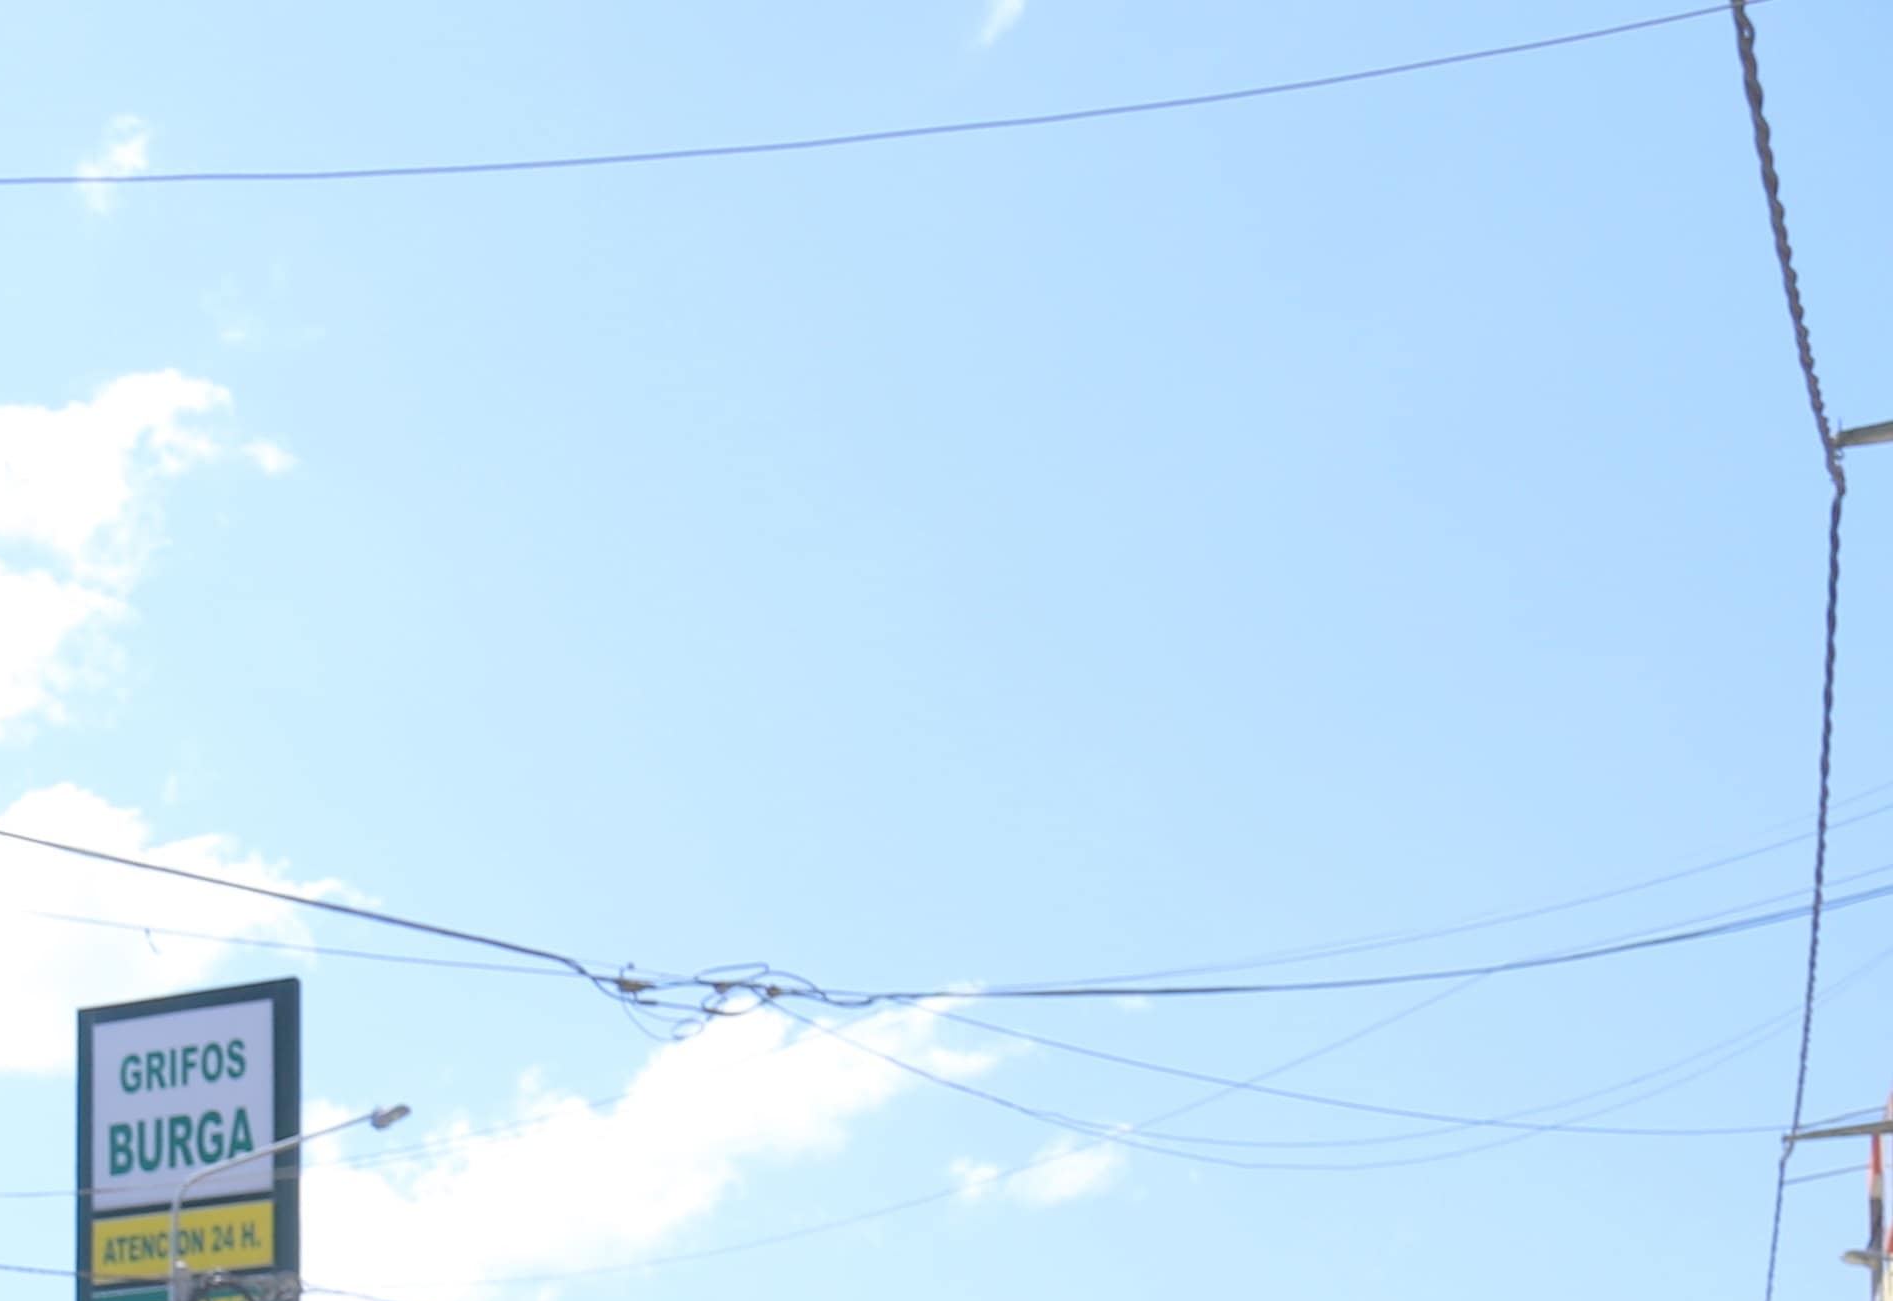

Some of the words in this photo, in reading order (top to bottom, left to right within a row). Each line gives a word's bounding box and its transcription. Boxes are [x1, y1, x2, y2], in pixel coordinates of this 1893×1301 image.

[120, 1038, 246, 1094] GRIFOS
[109, 1106, 254, 1176] BURGA
[103, 1228, 205, 1265] ATENCON
[211, 1224, 234, 1253] 24
